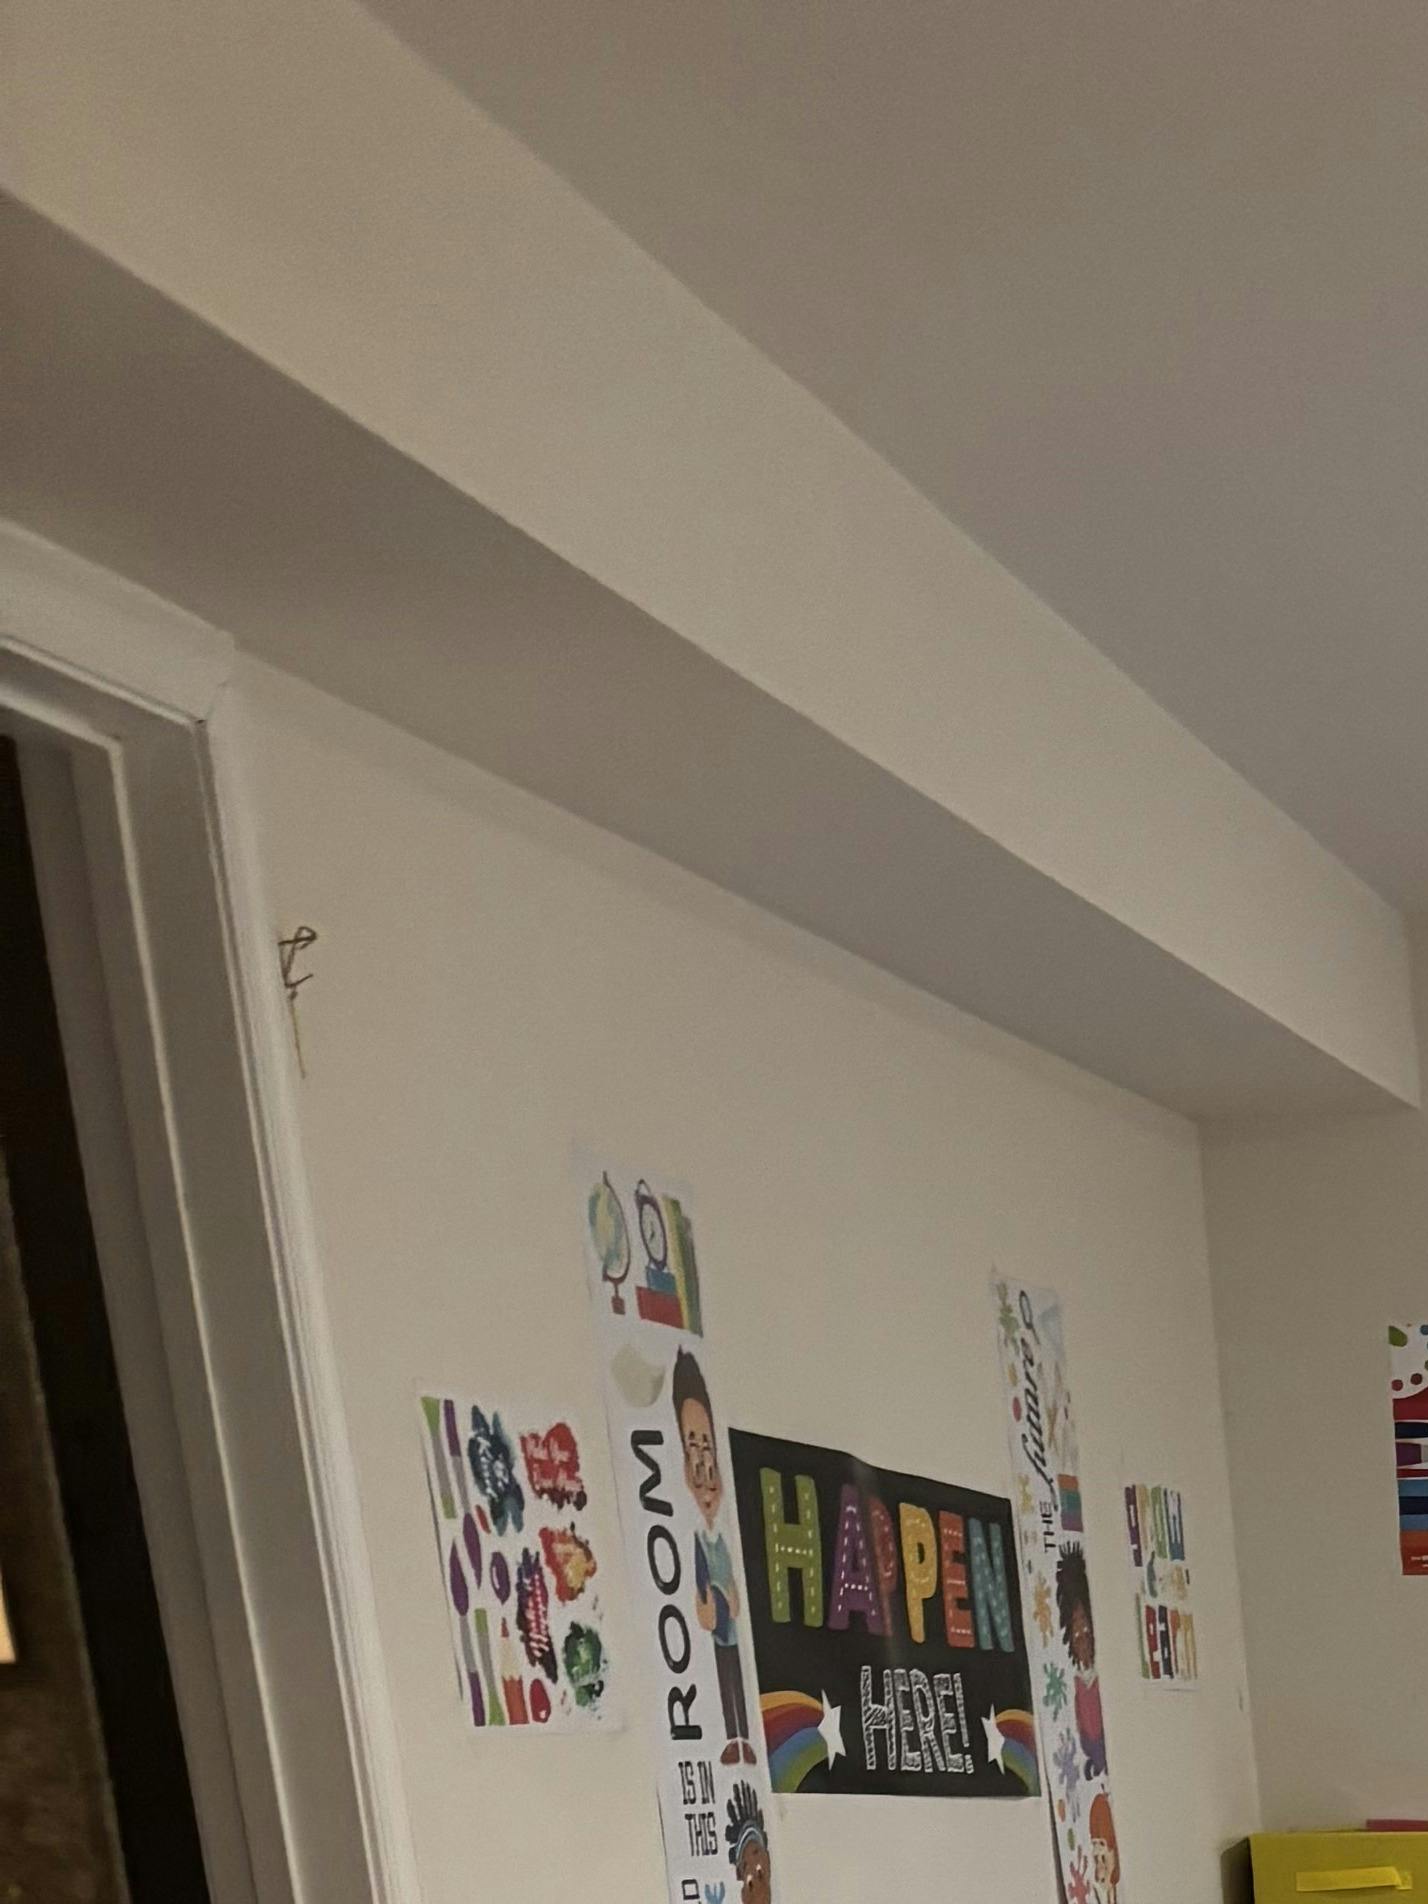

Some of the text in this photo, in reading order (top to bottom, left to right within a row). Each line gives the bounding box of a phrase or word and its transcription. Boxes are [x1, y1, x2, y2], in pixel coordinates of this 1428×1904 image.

[760, 1467, 1015, 1652] HAPPEN
[1039, 1500, 1057, 1554] THE
[631, 1430, 702, 1740] ROOM
[860, 1665, 974, 1774] HERE!
[678, 1761, 715, 1805] IS IN
[684, 1812, 718, 1856] THIS
